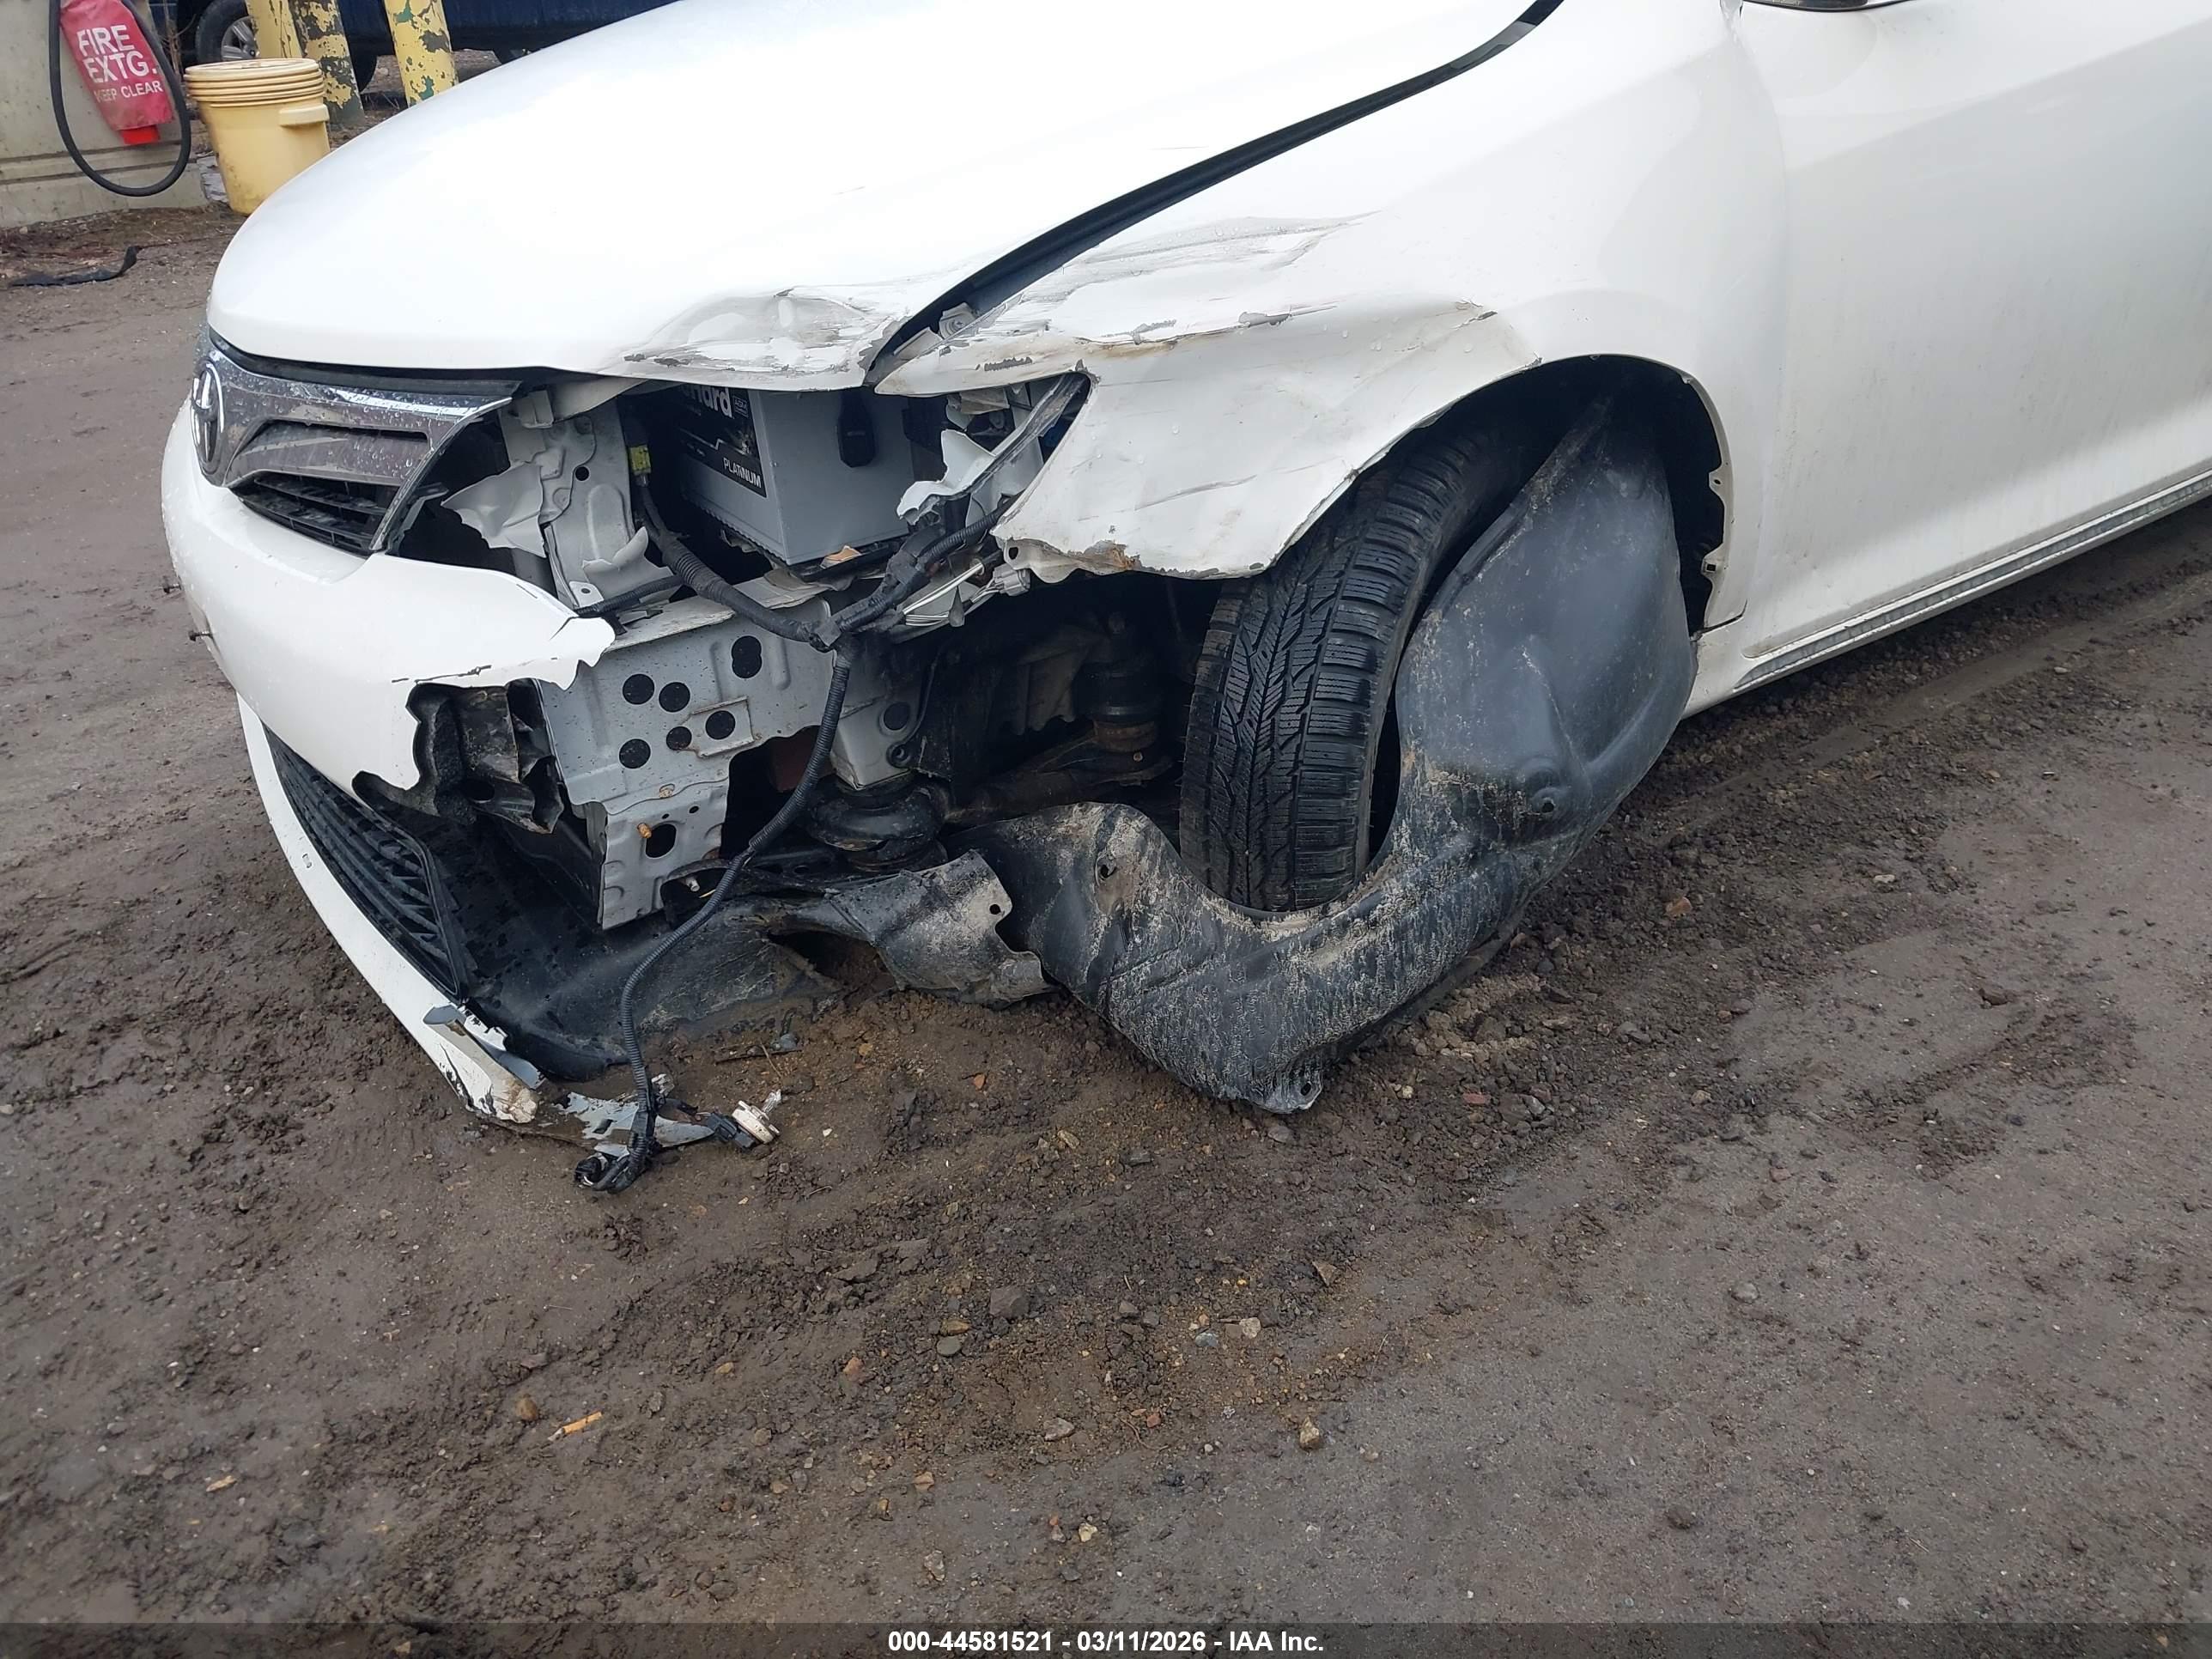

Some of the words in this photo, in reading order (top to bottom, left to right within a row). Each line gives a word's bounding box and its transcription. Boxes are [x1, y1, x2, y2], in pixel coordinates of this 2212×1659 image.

[76, 24, 135, 57] FIRE
[82, 50, 157, 83] EXTG.
[94, 88, 118, 103] KEEP
[120, 80, 164, 99] CLEAR
[723, 457, 762, 488] PLATINUM
